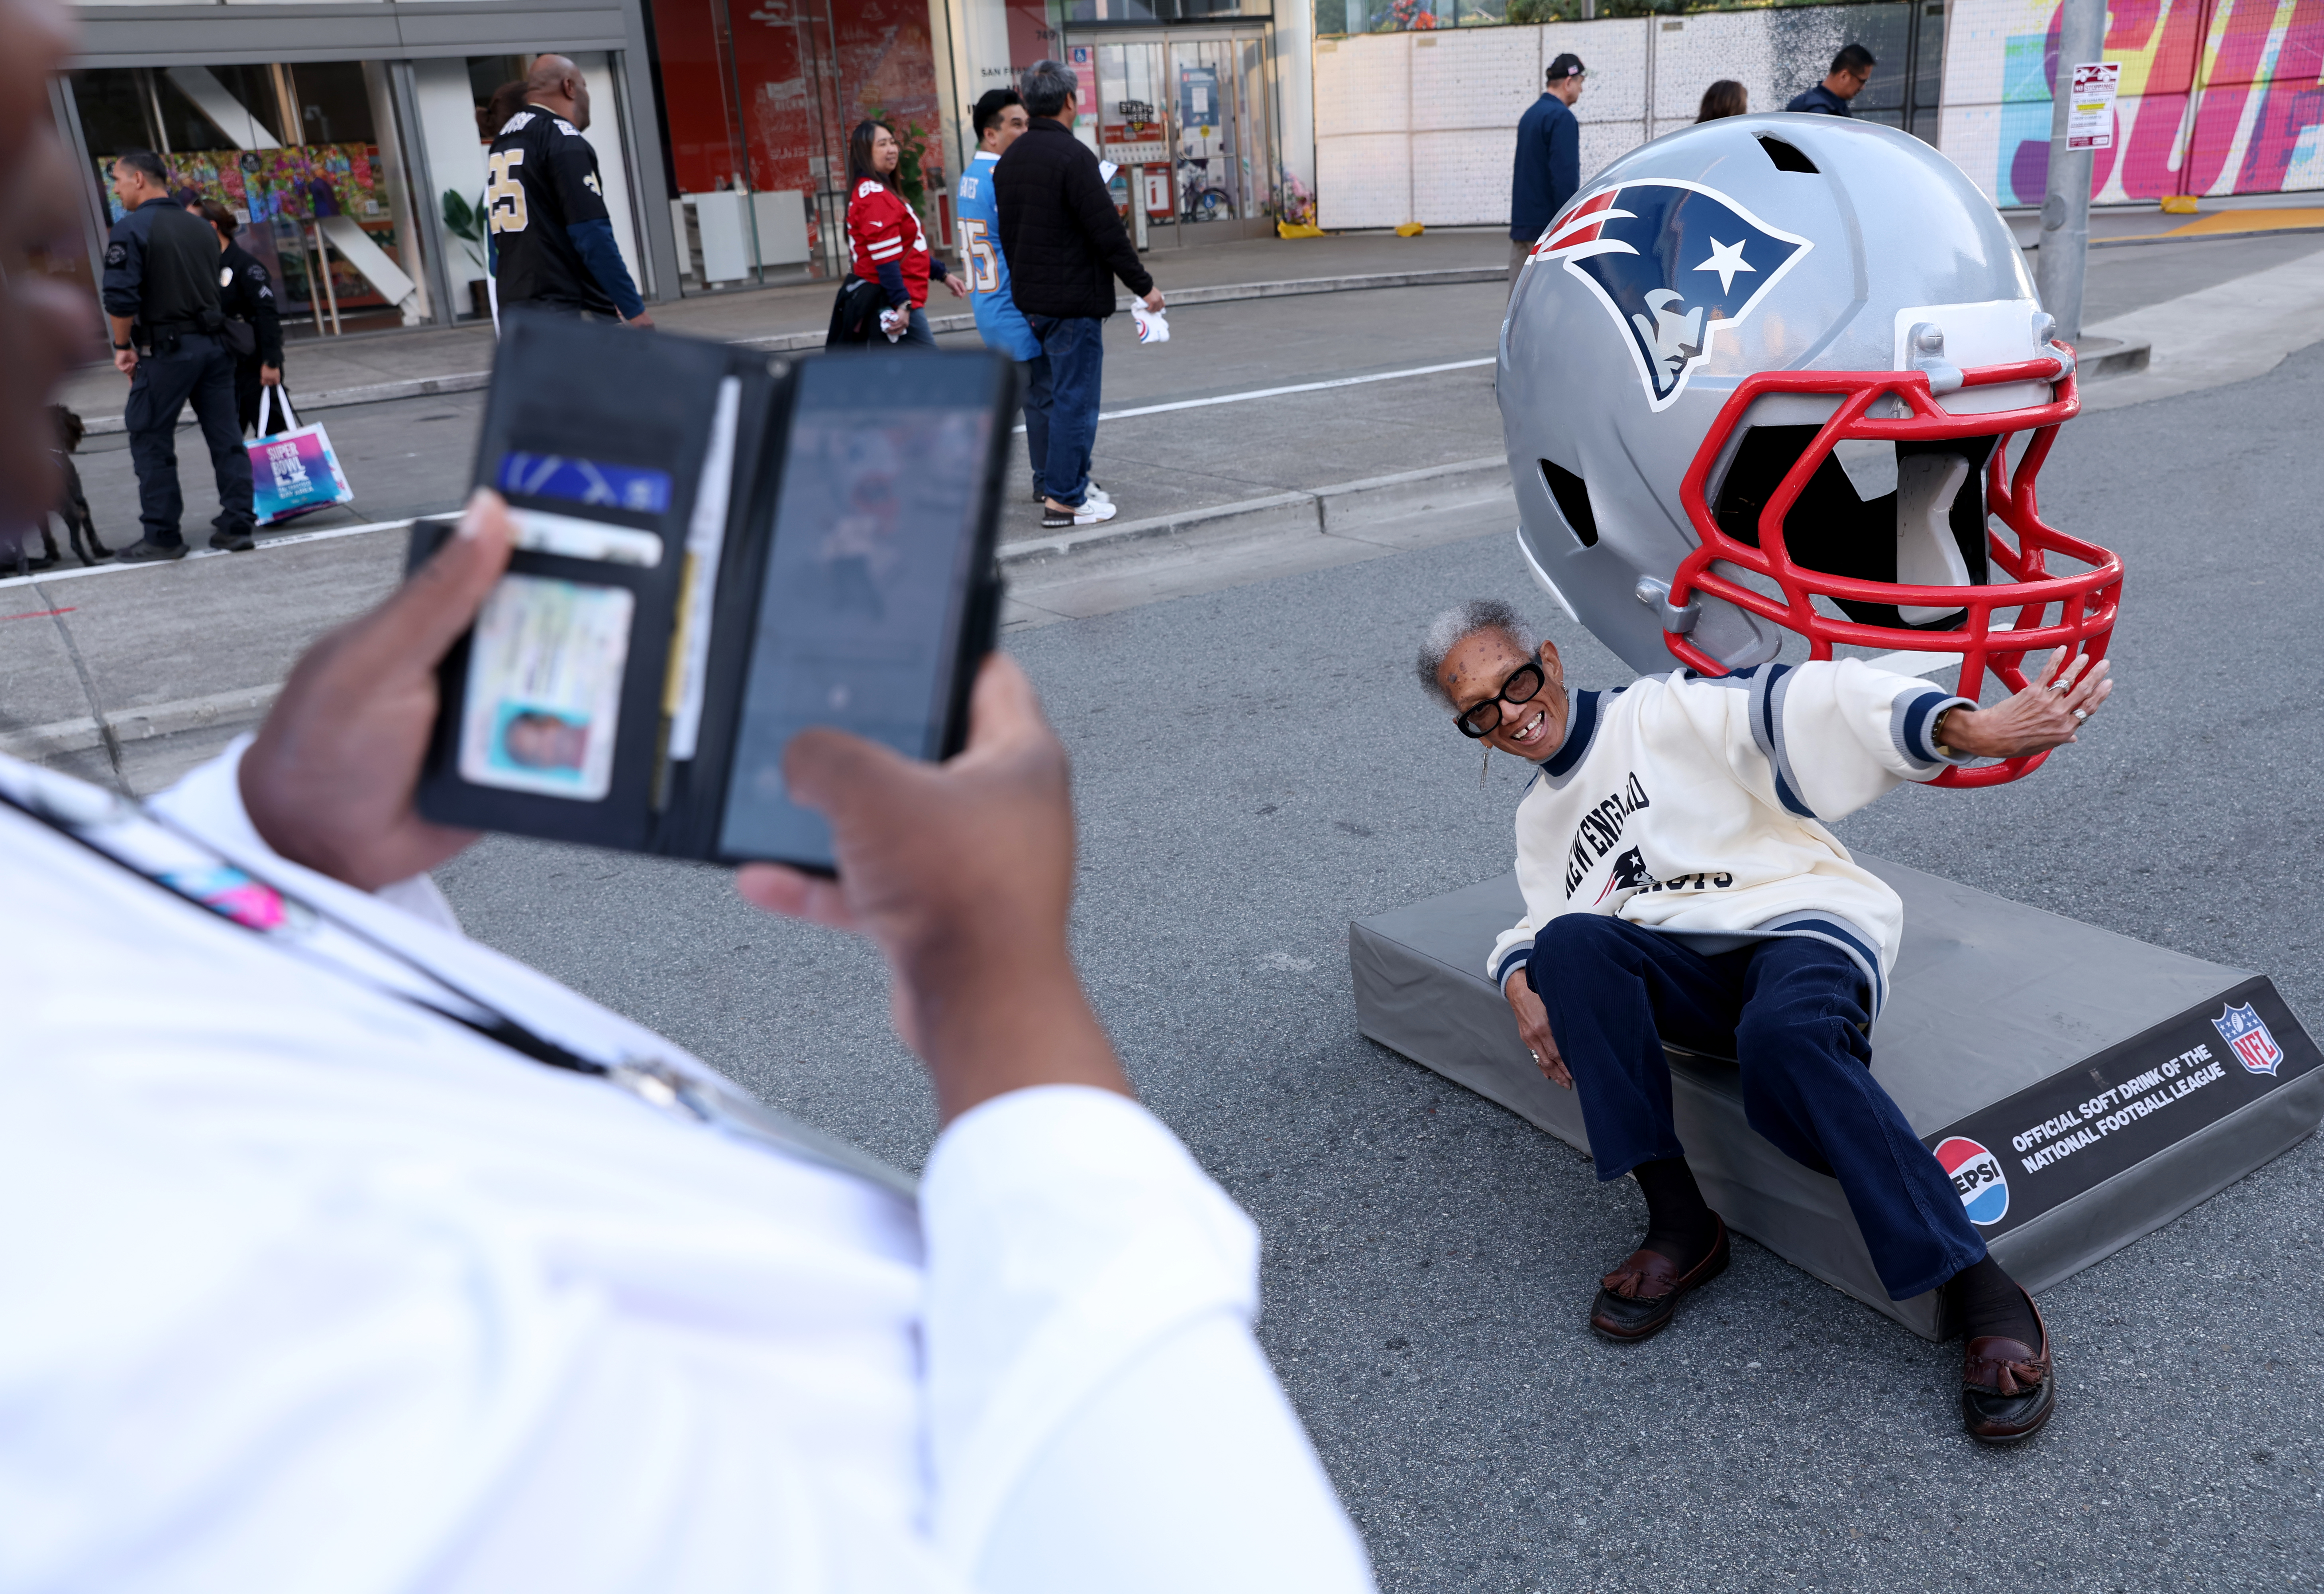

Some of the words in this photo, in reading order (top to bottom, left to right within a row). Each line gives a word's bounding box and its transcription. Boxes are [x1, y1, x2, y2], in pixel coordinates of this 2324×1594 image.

[981, 67, 1001, 77] SAN
[2074, 83, 2084, 92] NO
[2085, 83, 2114, 92] STOPPING
[488, 148, 529, 234] 25
[858, 180, 884, 198] 85
[266, 442, 299, 462] SUPER
[271, 456, 306, 477] BOWL
[276, 471, 310, 487] LX
[1565, 828, 1594, 901] NEW
[2233, 1031, 2276, 1066] NFL
[2012, 1110, 2083, 1152] OFFICIAL
[2079, 1088, 2120, 1119] SOFT
[2117, 1068, 2166, 1099] DRINK
[2161, 1058, 2181, 1077] OF
[2179, 1044, 2212, 1068] THE
[2021, 1127, 2101, 1174] NATIONAL
[2095, 1090, 2175, 1136] FOOTBALL
[2169, 1061, 2226, 1103] LEAGUE
[1952, 1159, 2000, 1196] EPSI
